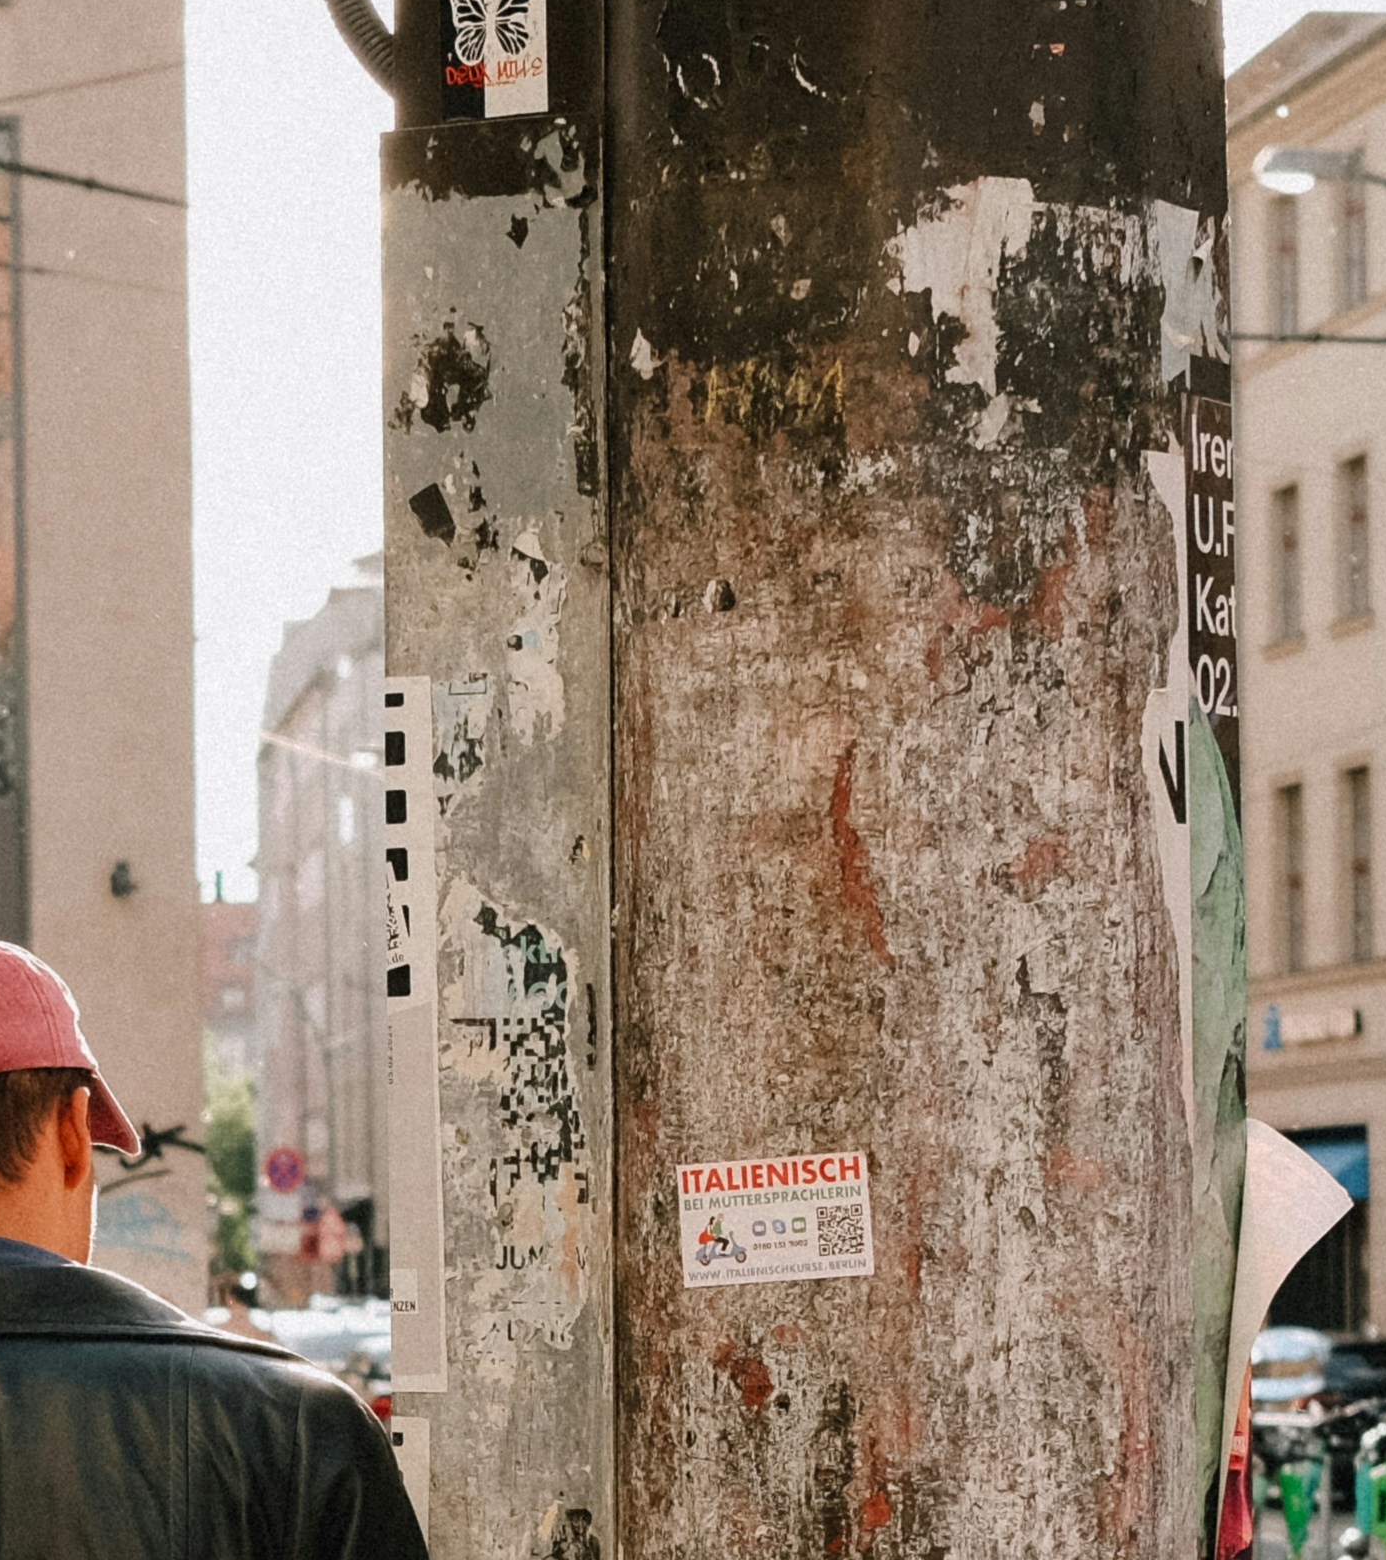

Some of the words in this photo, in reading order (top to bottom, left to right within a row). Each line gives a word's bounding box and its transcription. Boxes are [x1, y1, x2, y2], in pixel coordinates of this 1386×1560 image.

[682, 1156, 861, 1195] ITALIENISCH
[684, 1198, 704, 1211] BEI
[708, 1185, 862, 1210] MUTTERSPRACHLERIN
